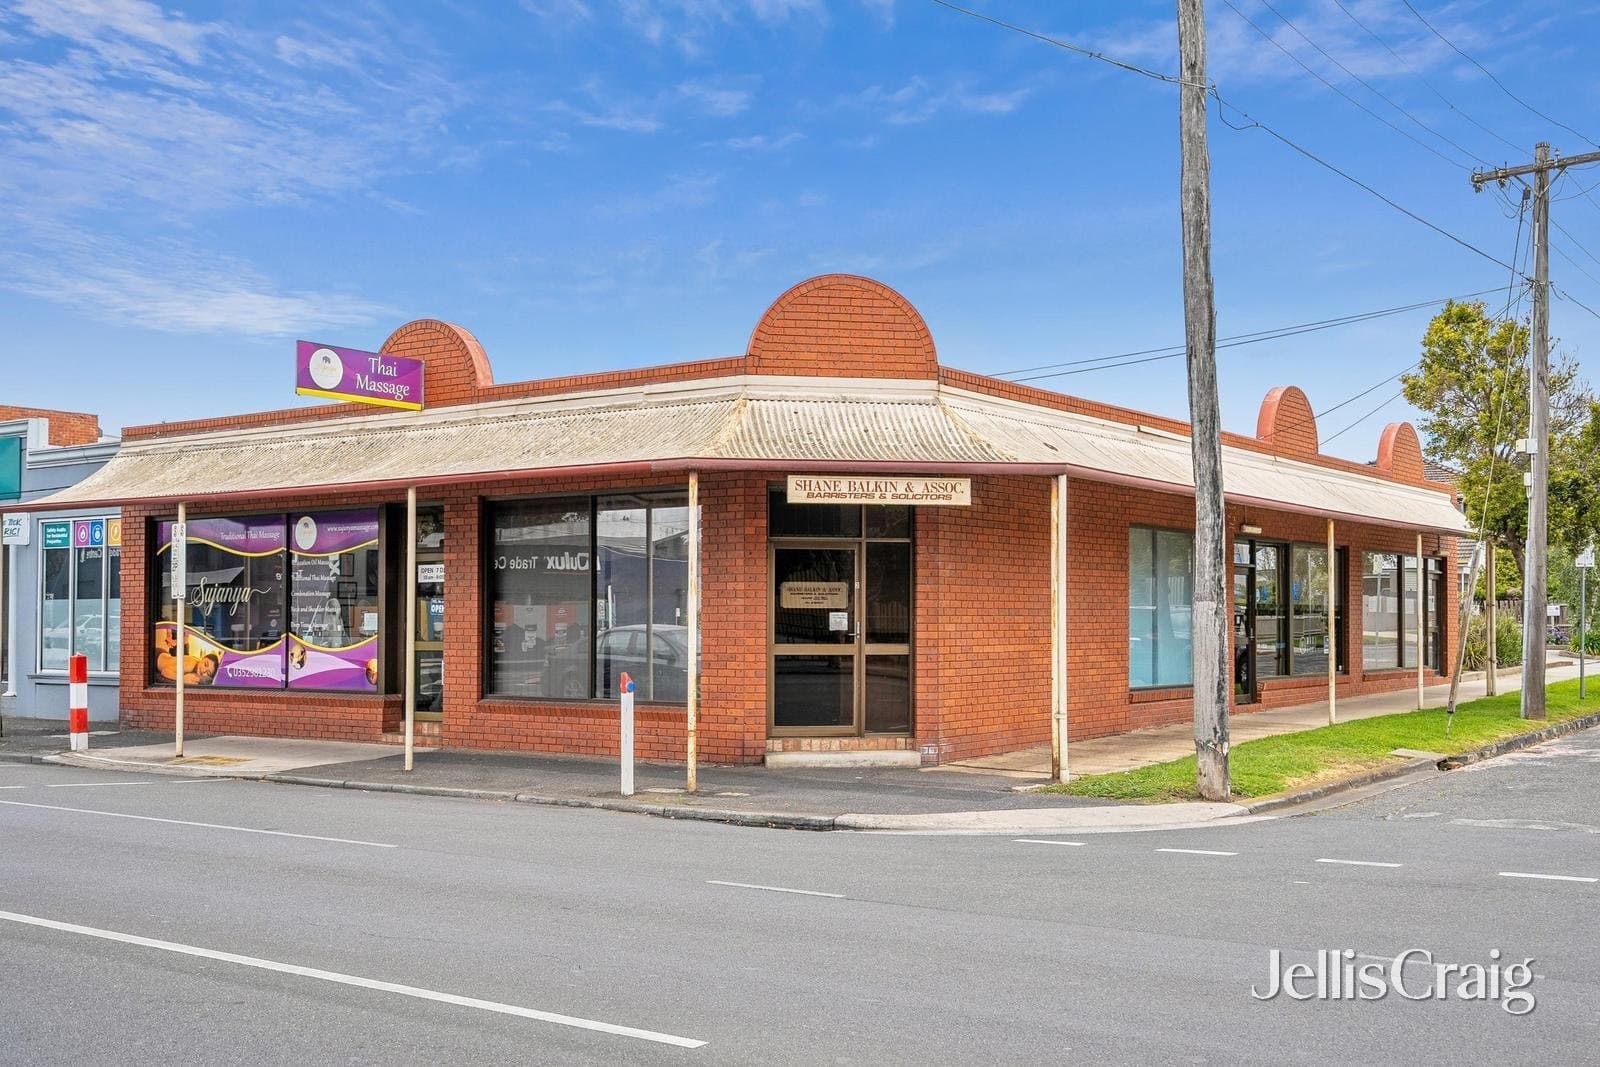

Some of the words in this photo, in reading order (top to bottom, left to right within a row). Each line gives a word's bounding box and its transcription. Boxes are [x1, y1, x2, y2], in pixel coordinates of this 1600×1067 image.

[368, 357, 397, 377] Thai
[356, 374, 410, 400] Massage
[794, 479, 842, 492] SHANE
[848, 480, 898, 493] BALKIN
[904, 481, 914, 494] &
[921, 481, 964, 495] ASSOC.
[806, 492, 875, 500] BARRISTERS
[891, 493, 953, 501] SOLICITORS
[220, 531, 246, 540] Traditional
[259, 530, 280, 542] Massage
[187, 576, 271, 617] Sujanya
